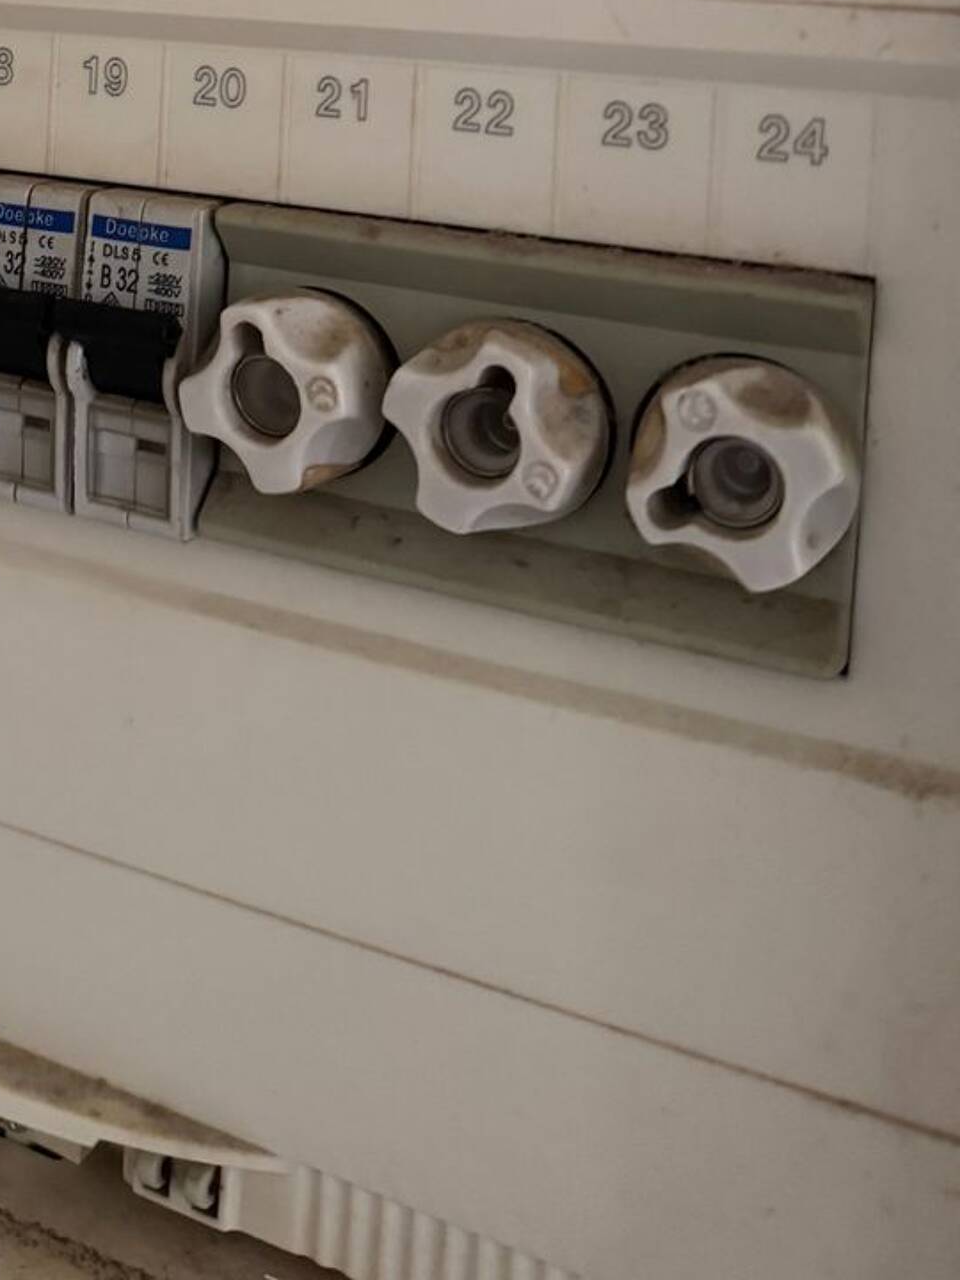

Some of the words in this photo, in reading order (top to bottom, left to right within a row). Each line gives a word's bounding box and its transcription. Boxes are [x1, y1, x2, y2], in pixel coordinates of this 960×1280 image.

[83, 54, 129, 97] 19
[192, 65, 247, 109] 20
[315, 75, 370, 122] 21
[452, 86, 516, 138] 22
[601, 99, 670, 151] 23
[756, 113, 830, 167] 24
[106, 217, 170, 243] Doepke
[3, 250, 25, 276] 32
[100, 263, 111, 289] B
[115, 266, 140, 295] 32
